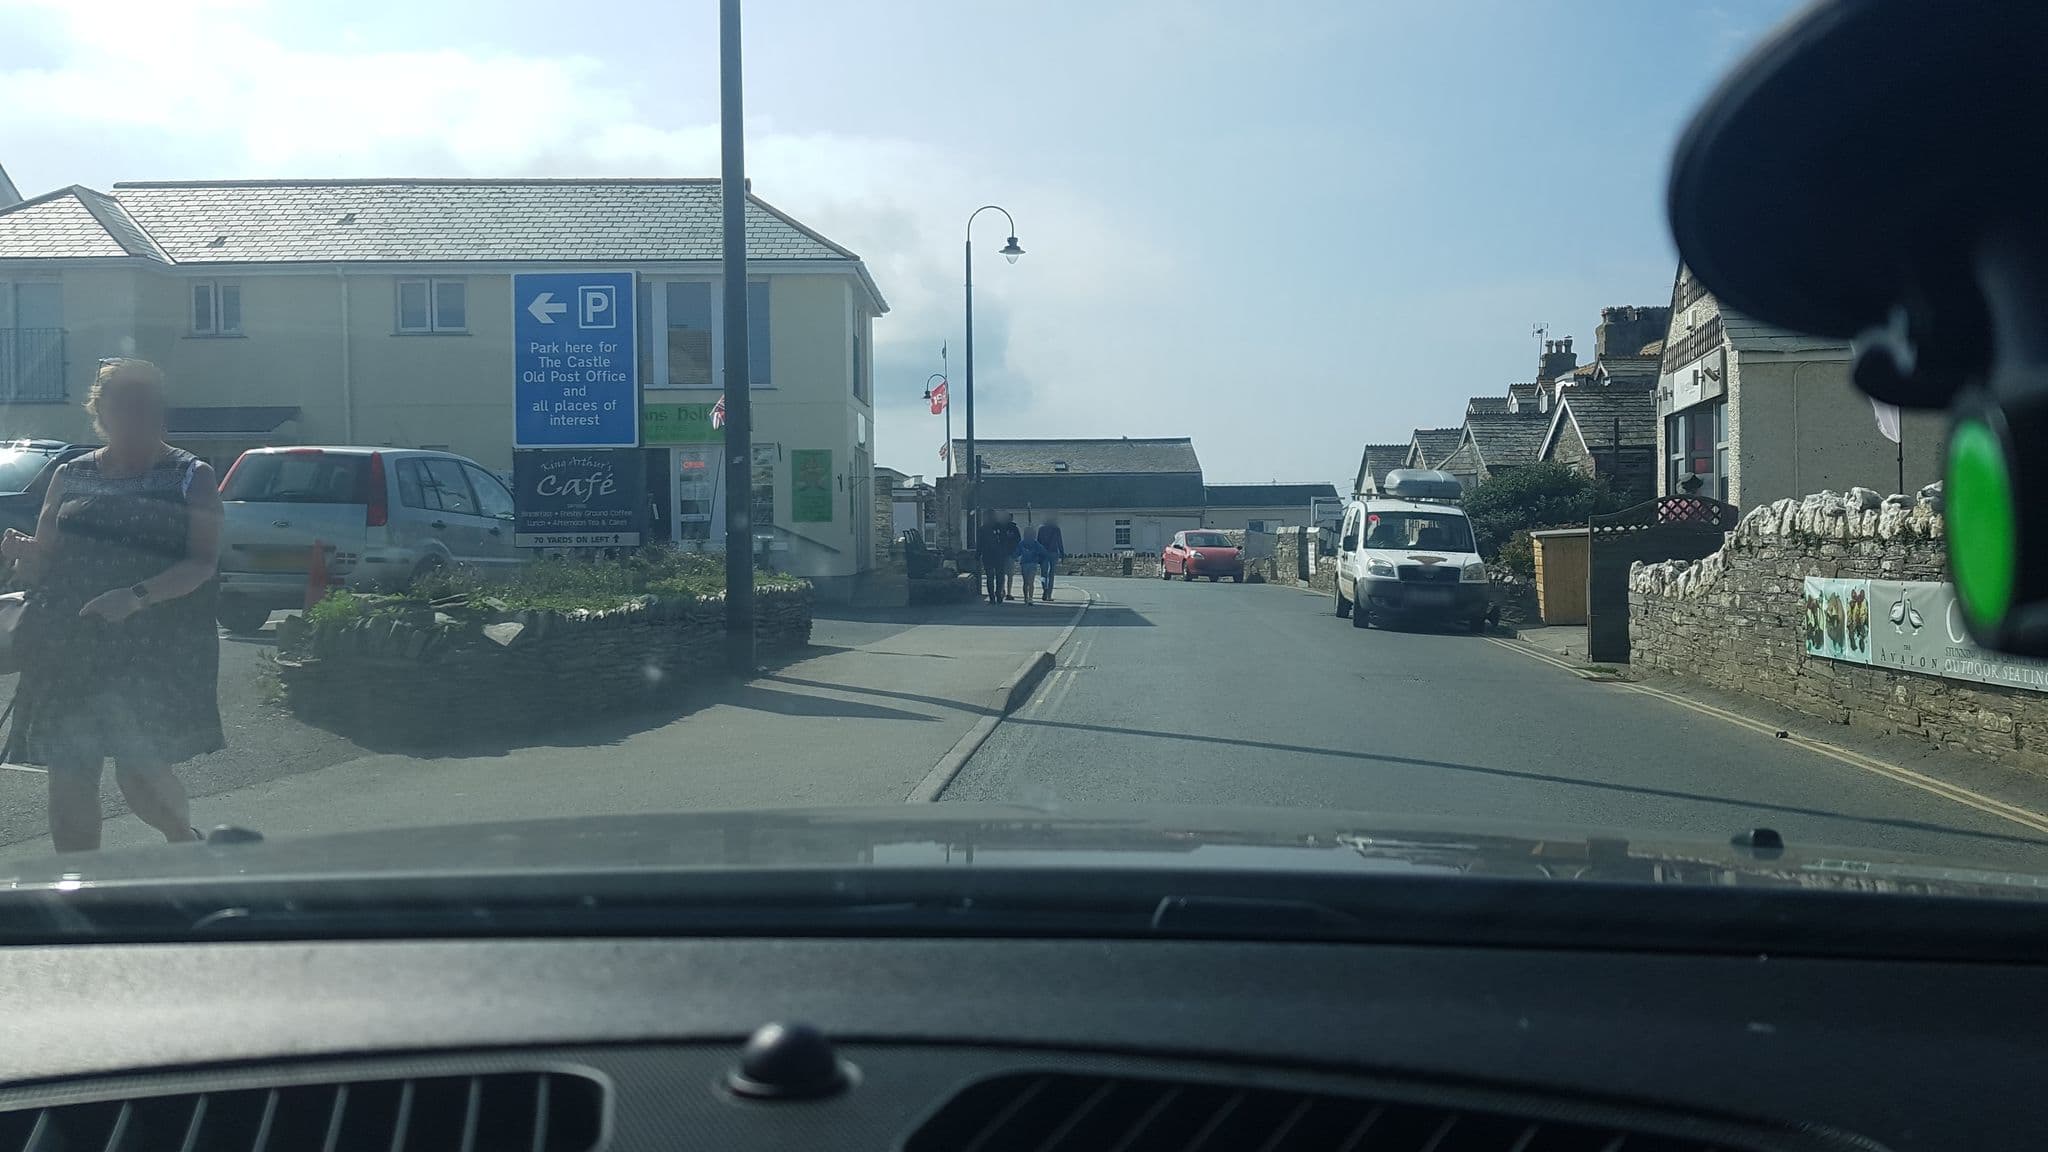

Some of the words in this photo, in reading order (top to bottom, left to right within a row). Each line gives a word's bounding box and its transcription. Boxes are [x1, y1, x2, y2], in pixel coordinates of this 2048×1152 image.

[586, 292, 609, 323] P
[530, 341, 560, 354] Park
[565, 341, 593, 353] here
[599, 341, 618, 353] for
[538, 356, 561, 368] The
[567, 356, 611, 368] Castle
[523, 370, 545, 383] Old
[551, 370, 581, 382] Post
[586, 370, 627, 382] Office
[563, 385, 587, 397] and
[532, 400, 549, 412] all
[554, 400, 598, 413] places
[603, 400, 617, 411] of
[550, 414, 600, 426] interest
[536, 471, 617, 503] Café
[534, 536, 544, 544] 70
[547, 536, 574, 544] YARDS
[1880, 647, 1939, 669] AVALON
[1944, 658, 1999, 679] OUTDOOR
